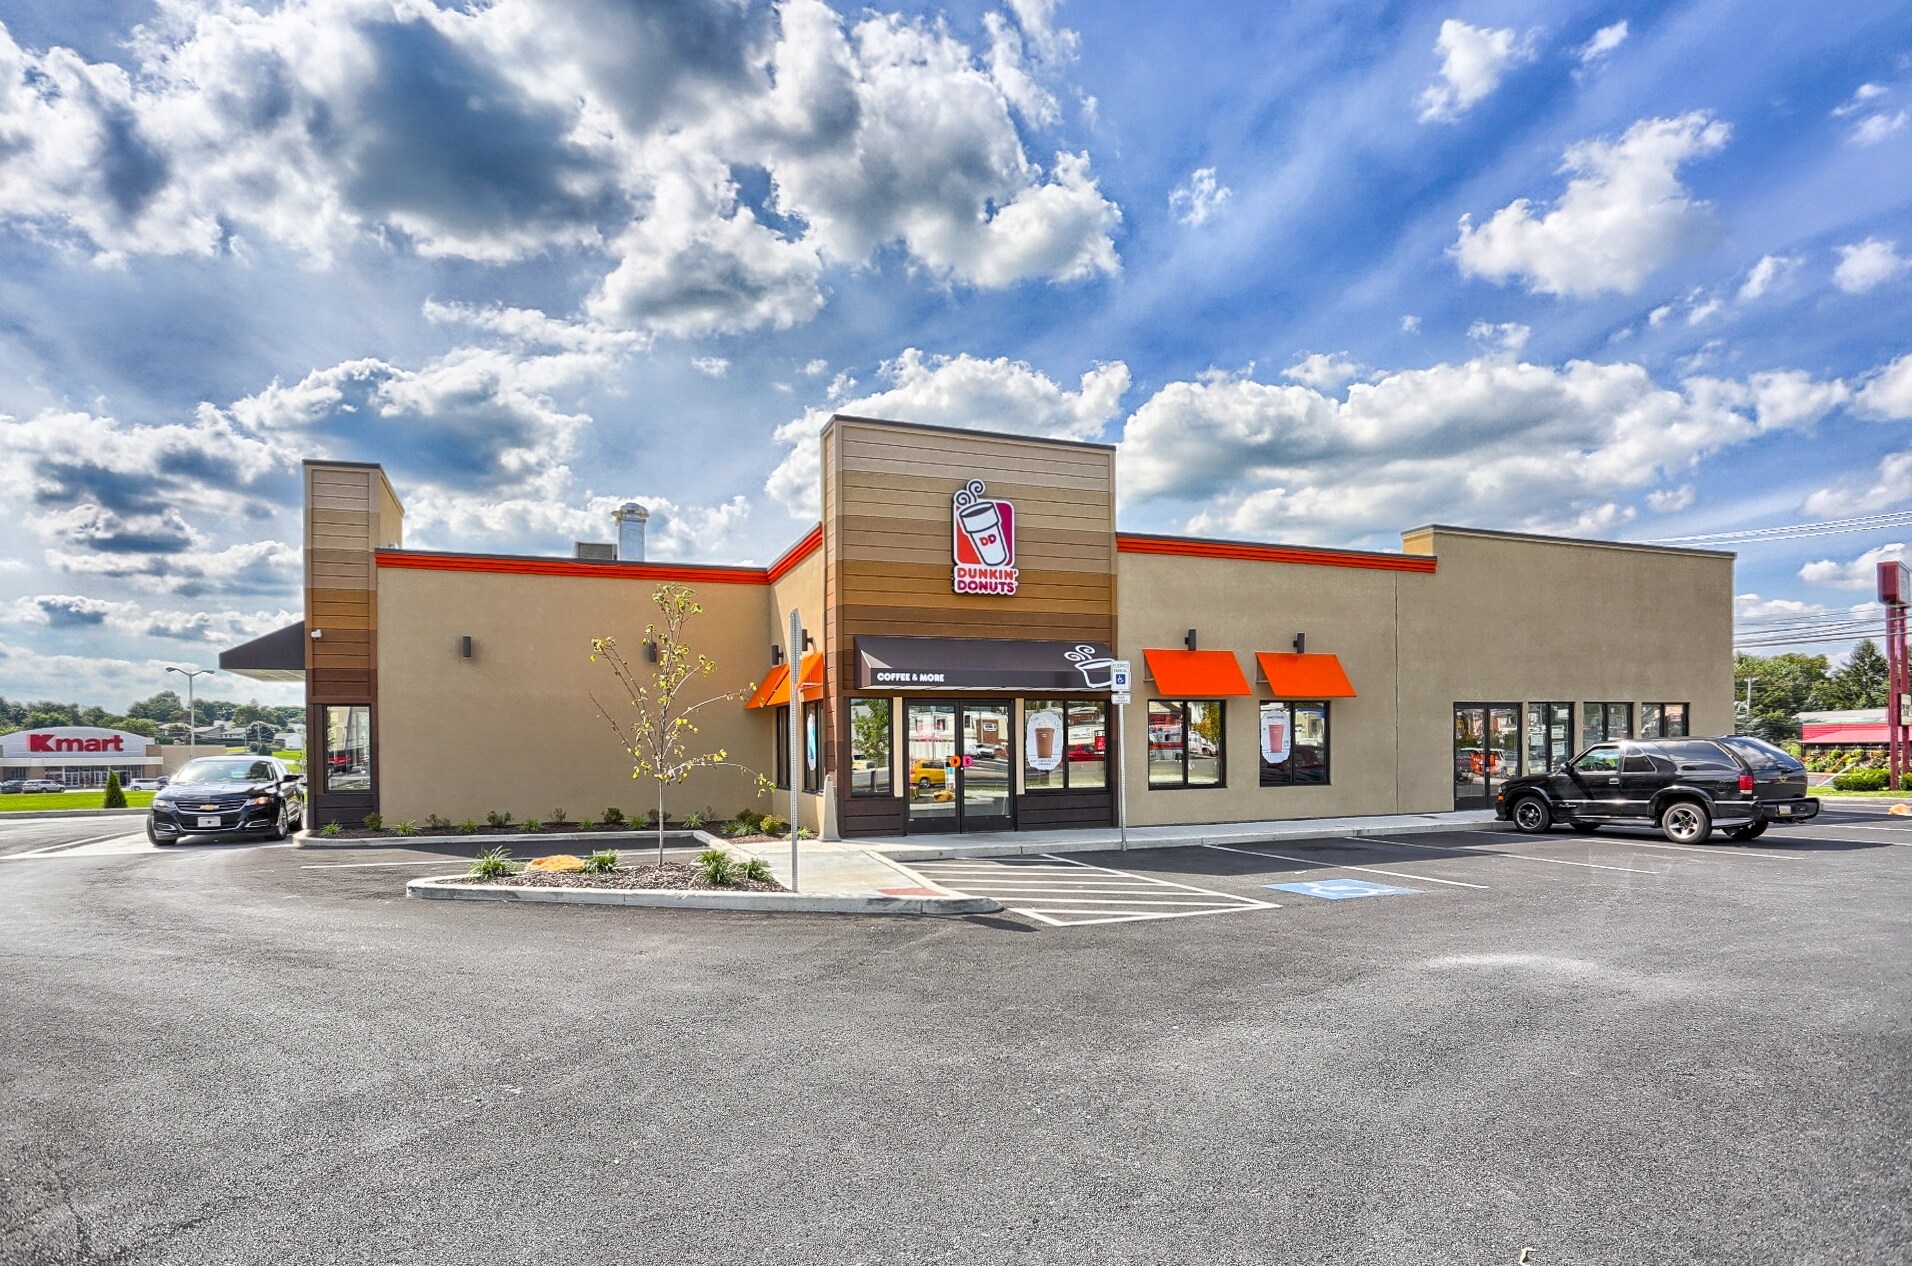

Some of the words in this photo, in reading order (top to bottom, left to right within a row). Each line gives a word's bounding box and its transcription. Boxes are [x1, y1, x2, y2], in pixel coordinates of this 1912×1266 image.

[979, 533, 997, 546] DD
[957, 567, 1017, 580] DUNKIN'
[957, 580, 1014, 593] DONUTS
[876, 672, 910, 682] COFFEE
[911, 673, 918, 682] &
[919, 673, 945, 682] MORE
[28, 734, 124, 752] Kmart
